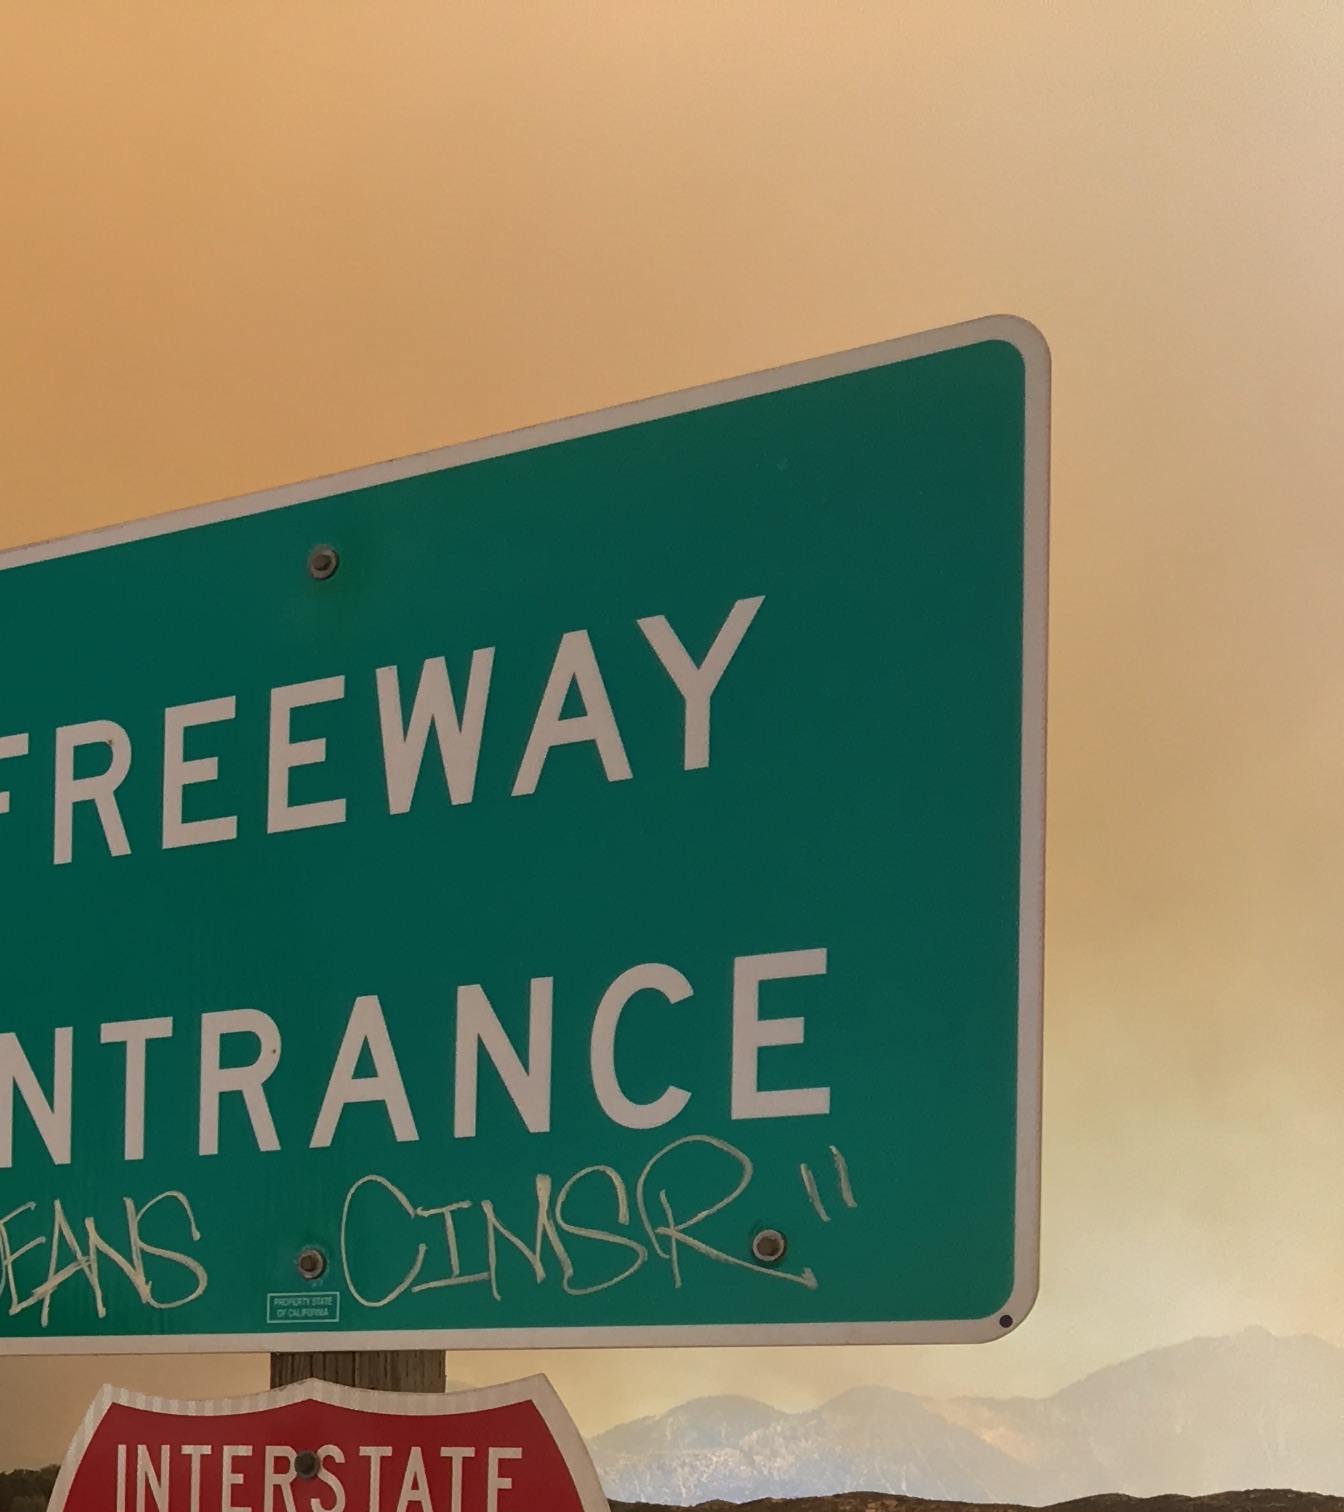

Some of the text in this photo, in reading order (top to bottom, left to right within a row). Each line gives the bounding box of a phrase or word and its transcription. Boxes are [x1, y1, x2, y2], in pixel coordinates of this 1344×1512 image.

[273, 1296, 332, 1306] PROPERTY STATE
[277, 1308, 329, 1317] OF CALIFORNIA
